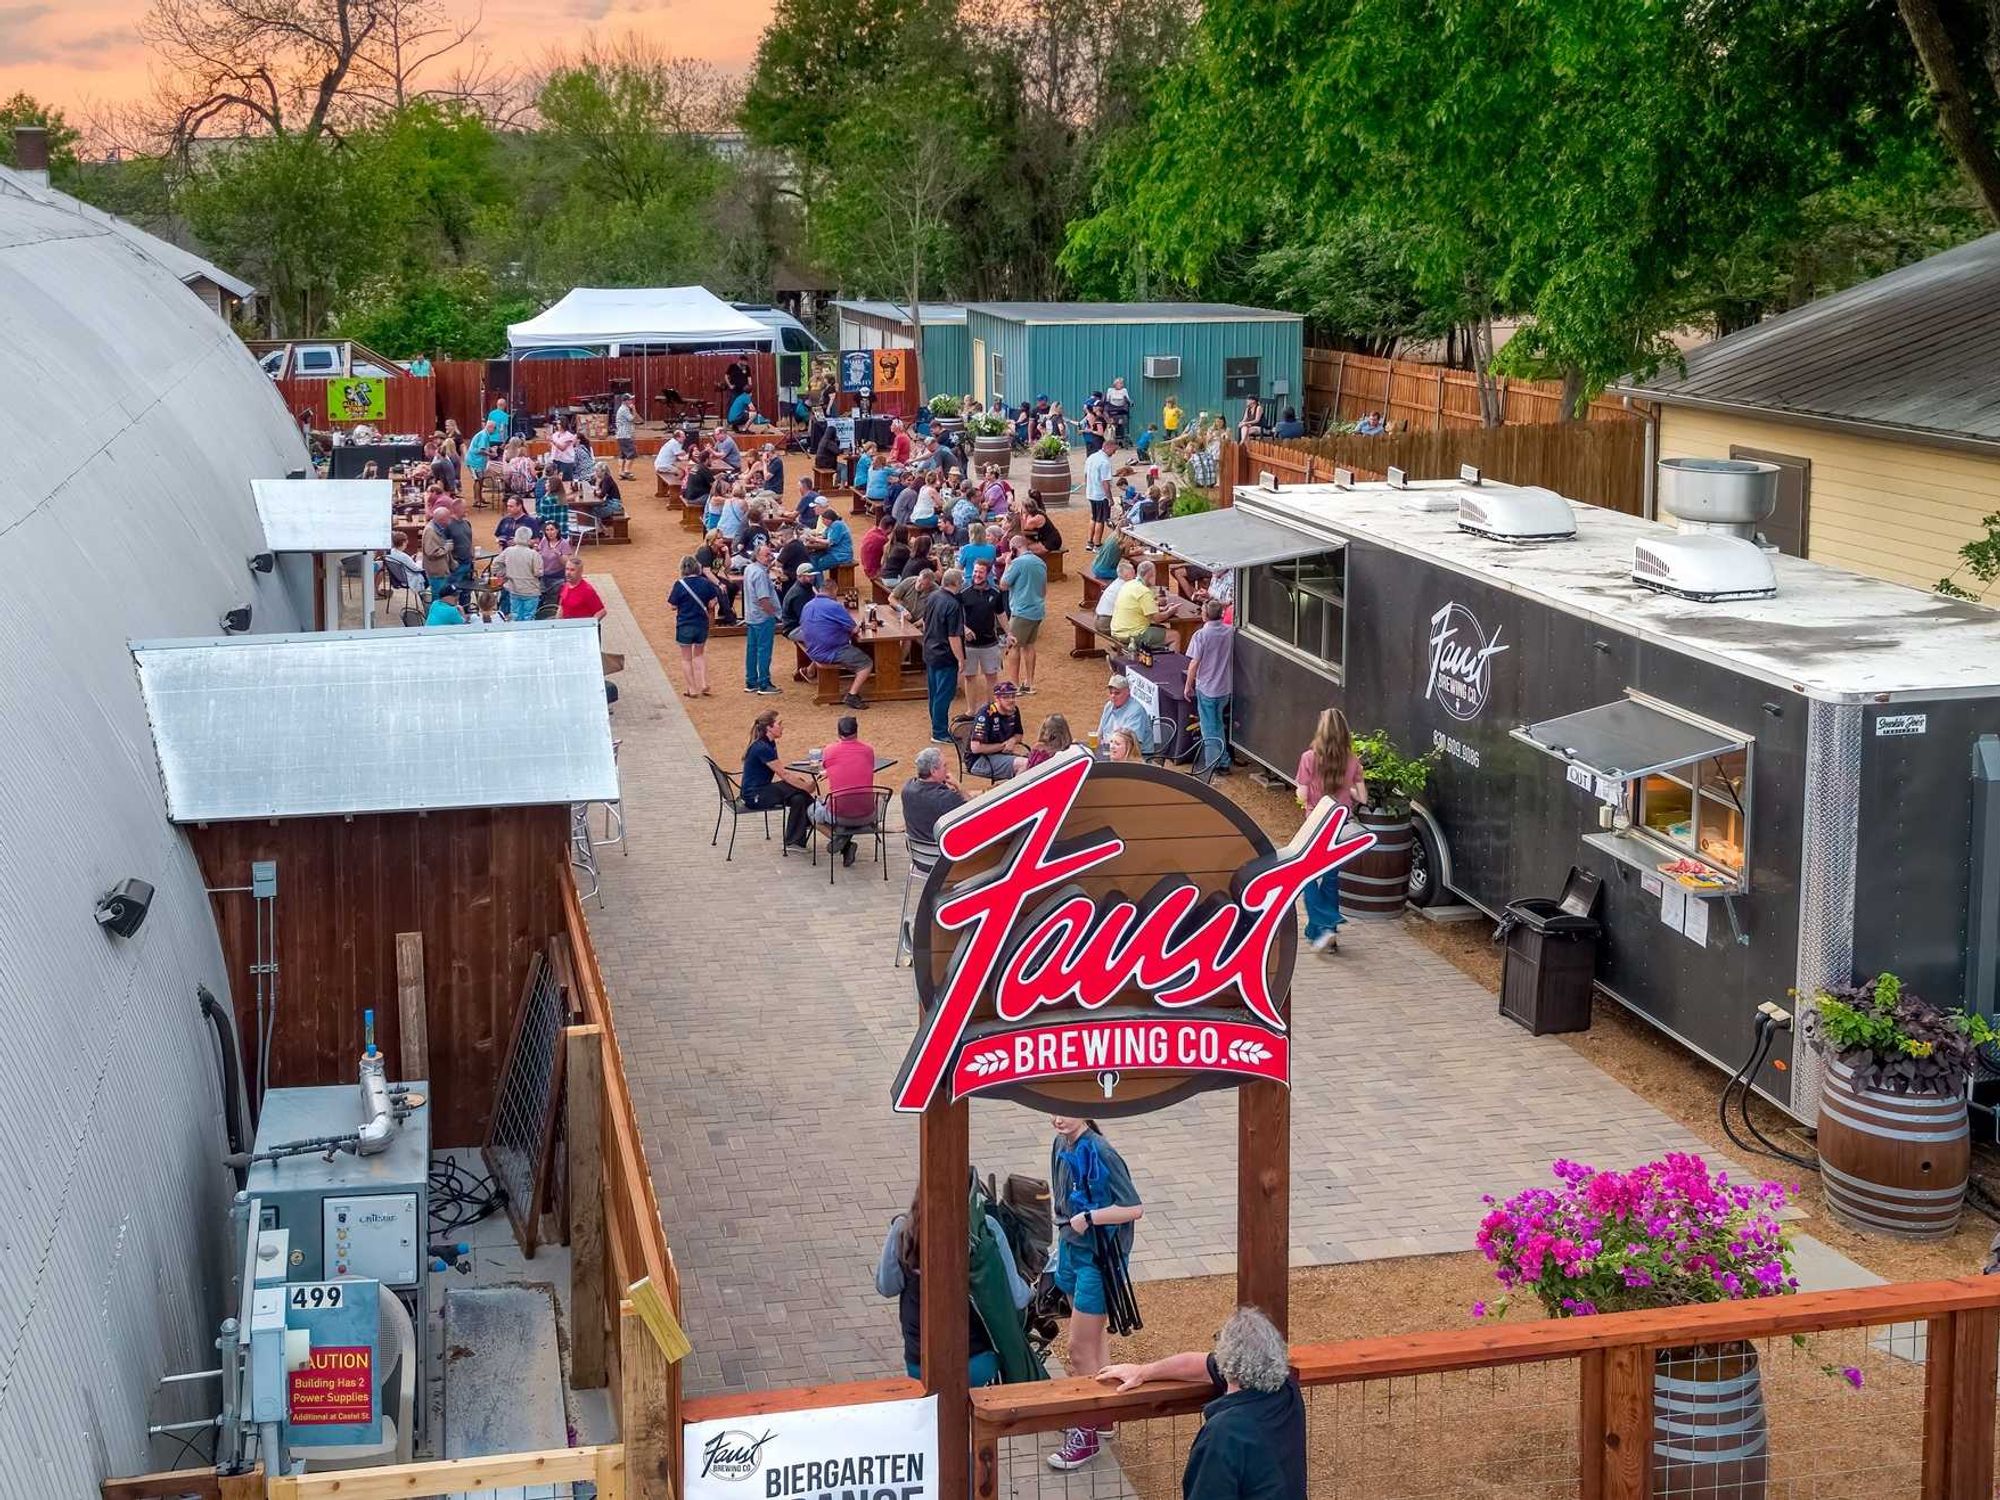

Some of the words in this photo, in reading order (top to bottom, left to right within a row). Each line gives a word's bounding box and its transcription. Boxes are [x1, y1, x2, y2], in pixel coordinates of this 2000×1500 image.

[1425, 601, 1510, 700] Faust
[893, 748, 1378, 1113] Faust
[1014, 1030, 1168, 1073] BREWING
[1177, 1029, 1229, 1066] CO.
[292, 1286, 342, 1308] 499
[308, 1353, 369, 1369] AUTION
[294, 1378, 335, 1390] Building
[337, 1378, 356, 1388] Has
[358, 1377, 365, 1388] 2
[293, 1393, 326, 1403] Power
[327, 1393, 369, 1404] Supplies
[293, 1413, 328, 1421] Additional
[701, 1428, 780, 1478] Faust
[713, 1464, 742, 1473] BREWING
[766, 1453, 924, 1498] BIERGARTEN
